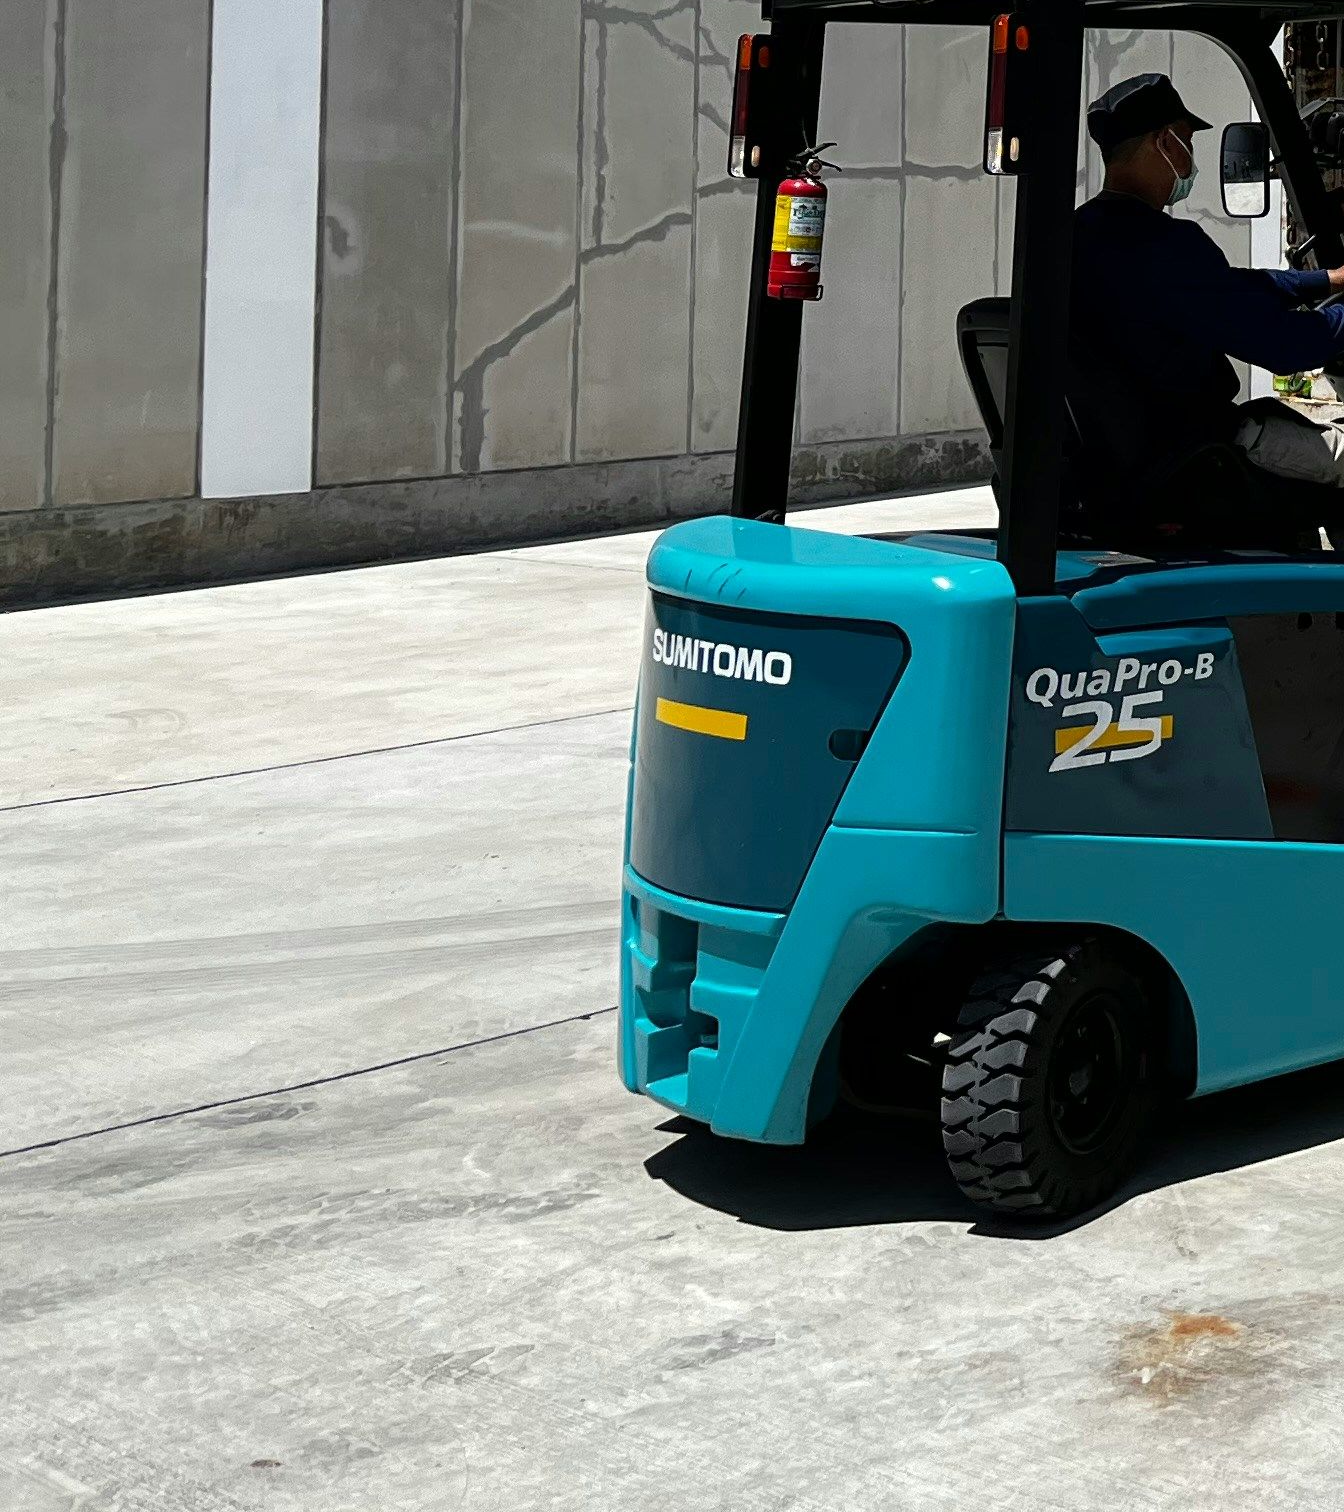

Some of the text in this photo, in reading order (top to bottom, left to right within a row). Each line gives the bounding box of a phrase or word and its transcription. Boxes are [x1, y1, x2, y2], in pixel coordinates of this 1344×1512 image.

[652, 628, 792, 685] SUMITOMO
[1026, 652, 1215, 708] QuaPro-B
[1048, 690, 1163, 773] 25
